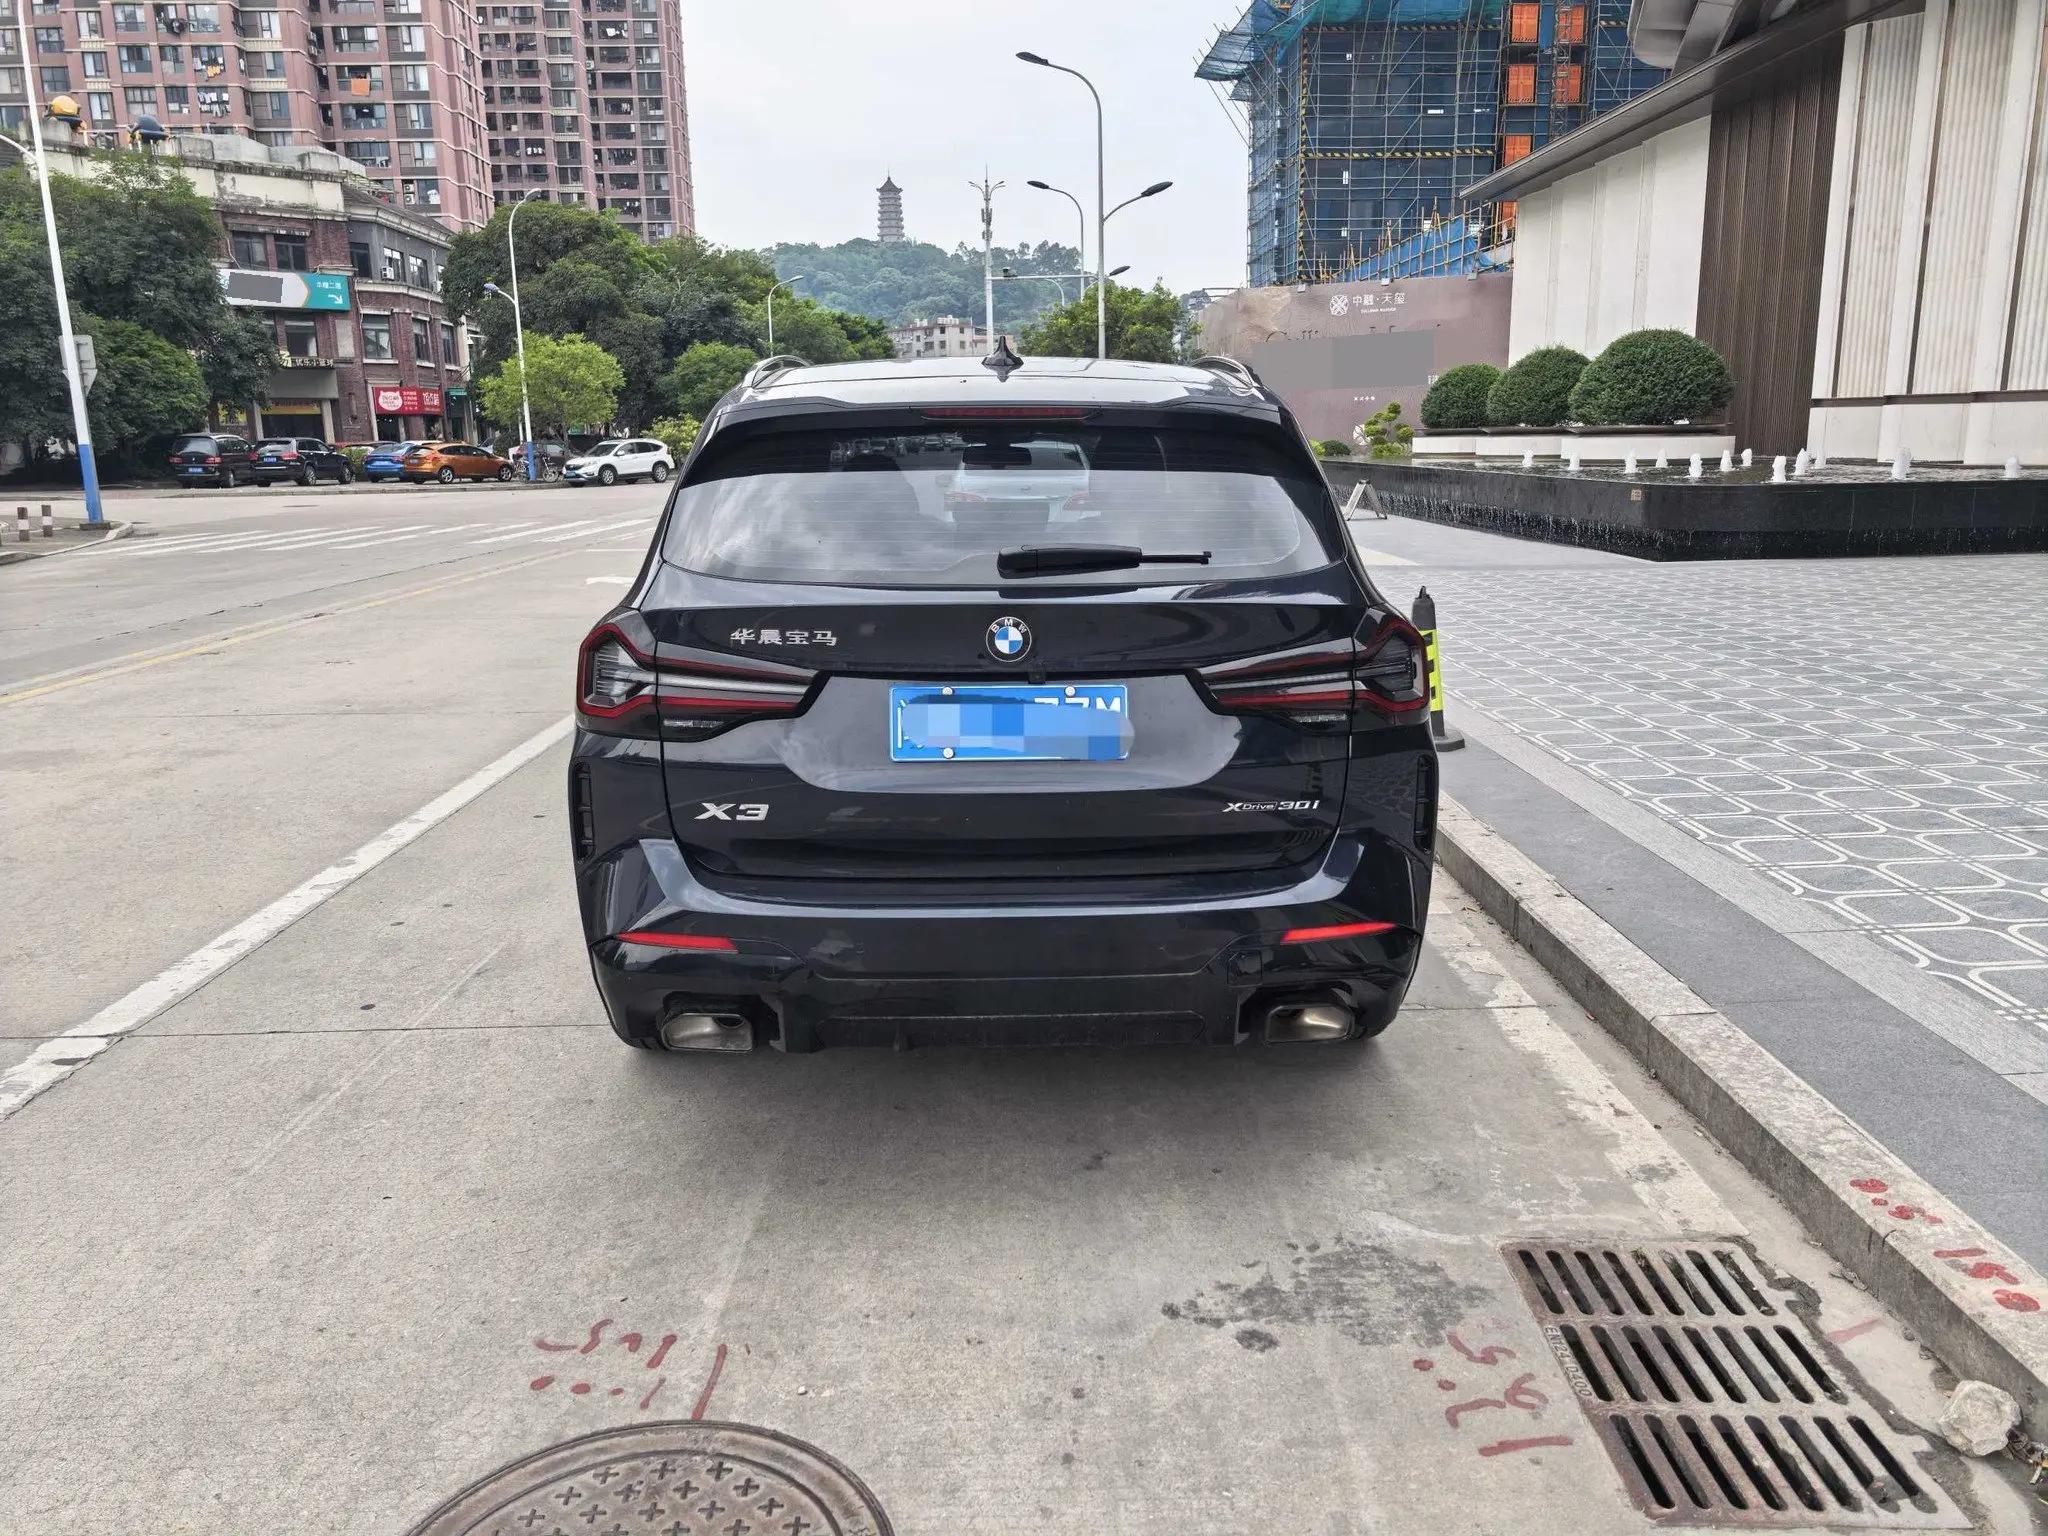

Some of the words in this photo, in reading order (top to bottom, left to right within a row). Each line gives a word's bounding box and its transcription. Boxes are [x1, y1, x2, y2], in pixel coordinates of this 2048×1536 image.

[730, 628, 838, 647] 华晨宝马
[693, 802, 770, 821] X3
